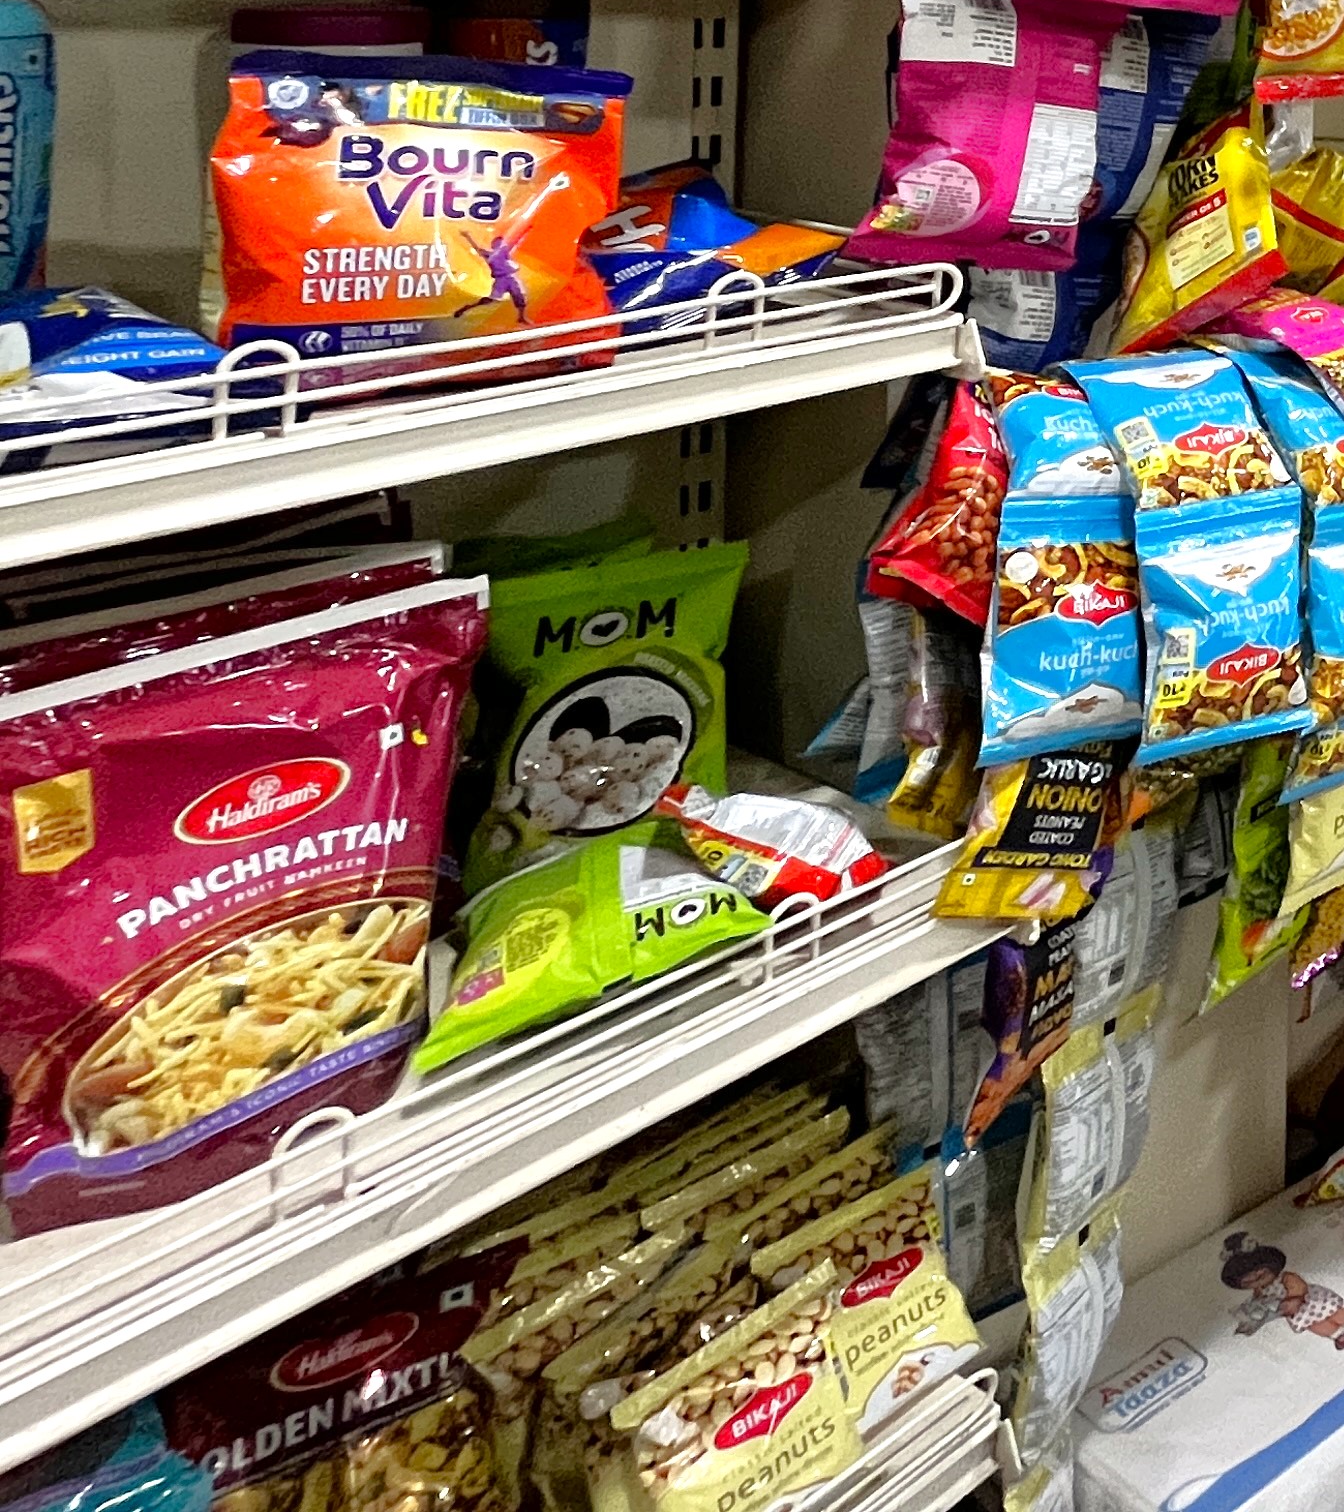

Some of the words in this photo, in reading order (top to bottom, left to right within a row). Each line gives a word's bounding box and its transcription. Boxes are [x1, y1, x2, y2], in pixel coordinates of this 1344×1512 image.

[337, 134, 536, 181] Bourn
[366, 173, 504, 230] Vita
[302, 244, 448, 276] STRENGTH
[302, 275, 388, 305] EVERY
[396, 273, 449, 299] DAY
[533, 597, 678, 658] MOM
[1219, 654, 1268, 676] BIKAJI
[207, 780, 323, 834] Haldiram's
[1027, 783, 1103, 813] ONION
[117, 816, 410, 939] PANCHRATTAN
[855, 1256, 912, 1297] BIKAJI
[845, 1287, 947, 1372] peanuts
[1100, 1349, 1176, 1409] Amul
[201, 1396, 335, 1476] OLDEN
[732, 1383, 798, 1440] BIKAJI
[716, 1417, 836, 1512] peanuts
